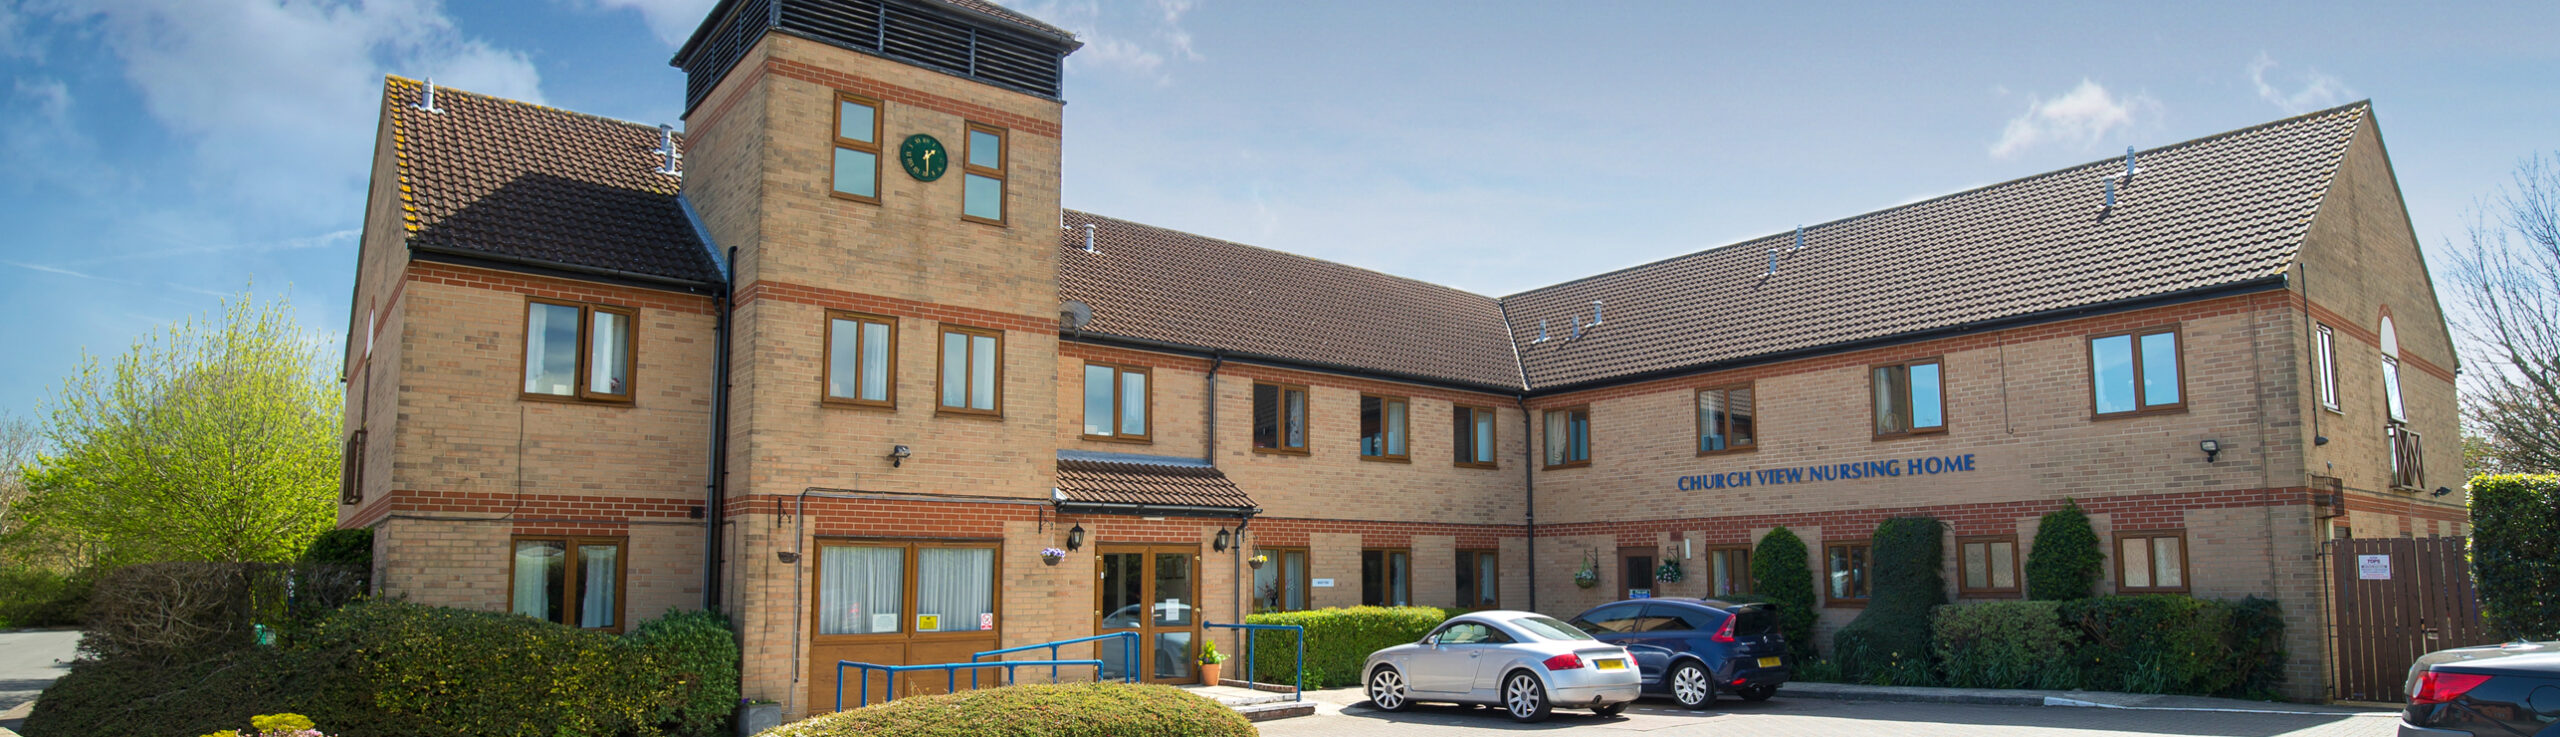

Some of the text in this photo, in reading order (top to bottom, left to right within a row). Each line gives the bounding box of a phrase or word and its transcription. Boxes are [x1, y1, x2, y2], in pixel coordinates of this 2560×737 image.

[1677, 454, 1976, 491] CHURCH VIEW NURSING HOME
